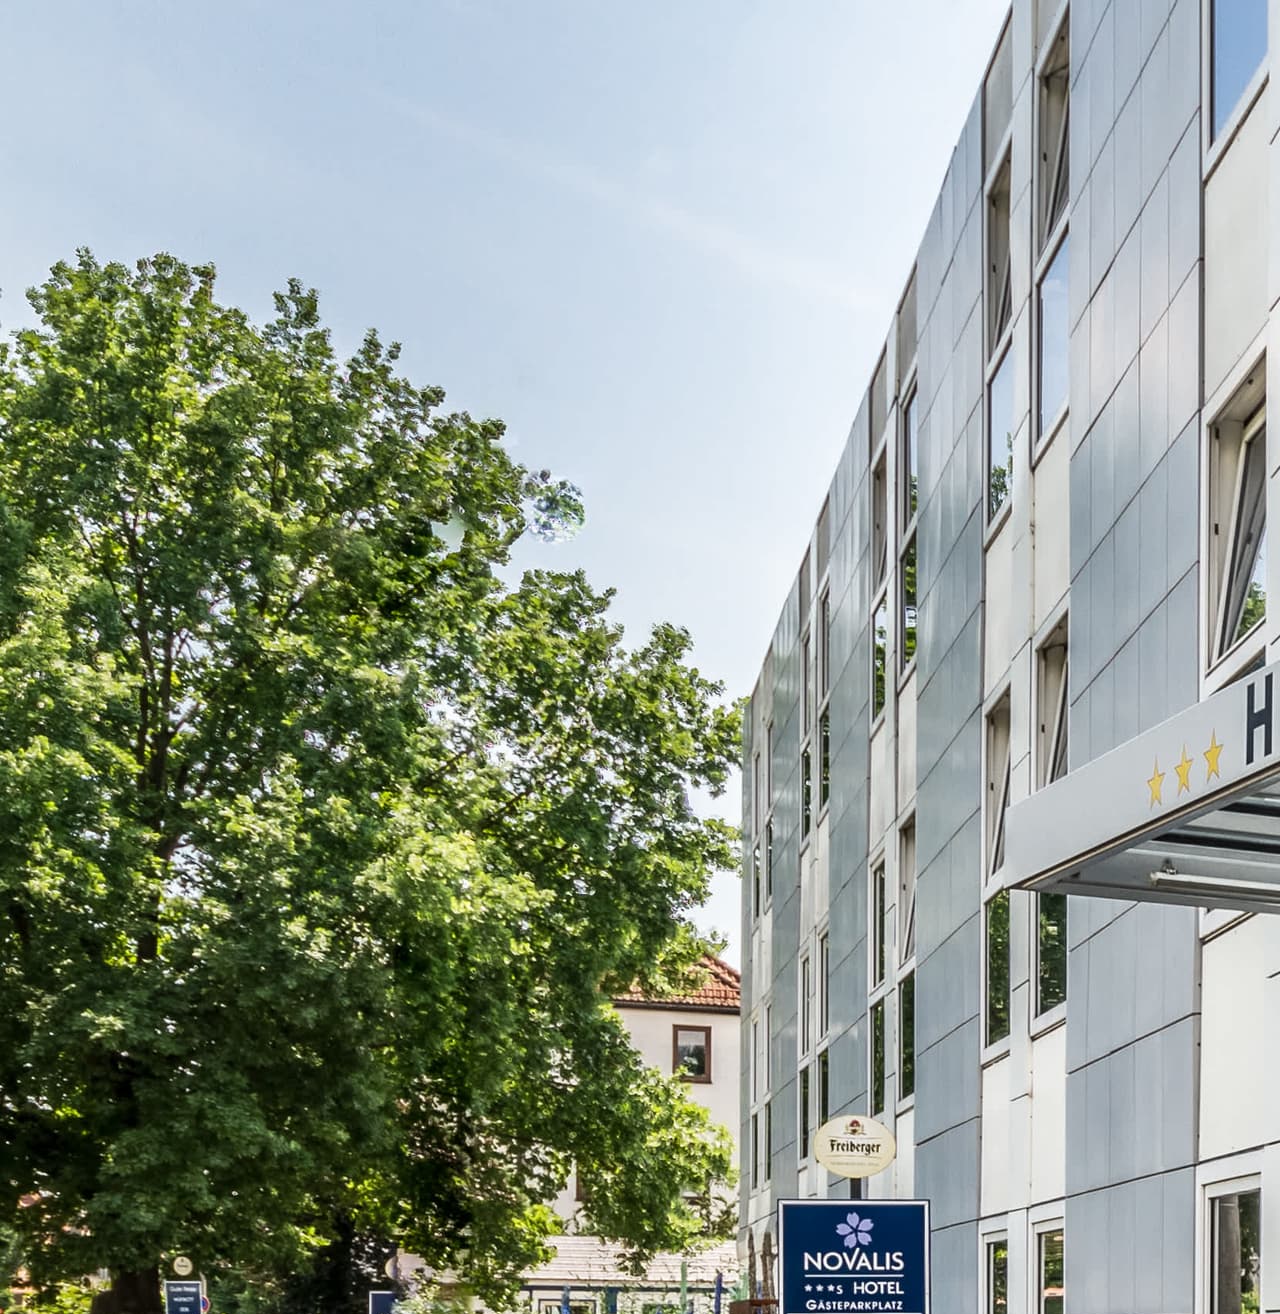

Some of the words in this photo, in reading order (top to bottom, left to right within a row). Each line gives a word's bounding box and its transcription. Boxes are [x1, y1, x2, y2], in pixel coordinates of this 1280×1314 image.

[829, 1139, 881, 1156] Freiberger
[803, 1248, 905, 1271] NOVALIS
[853, 1281, 905, 1295] HOTEL
[806, 1299, 903, 1311] GÄSTEPARKPLATZ
